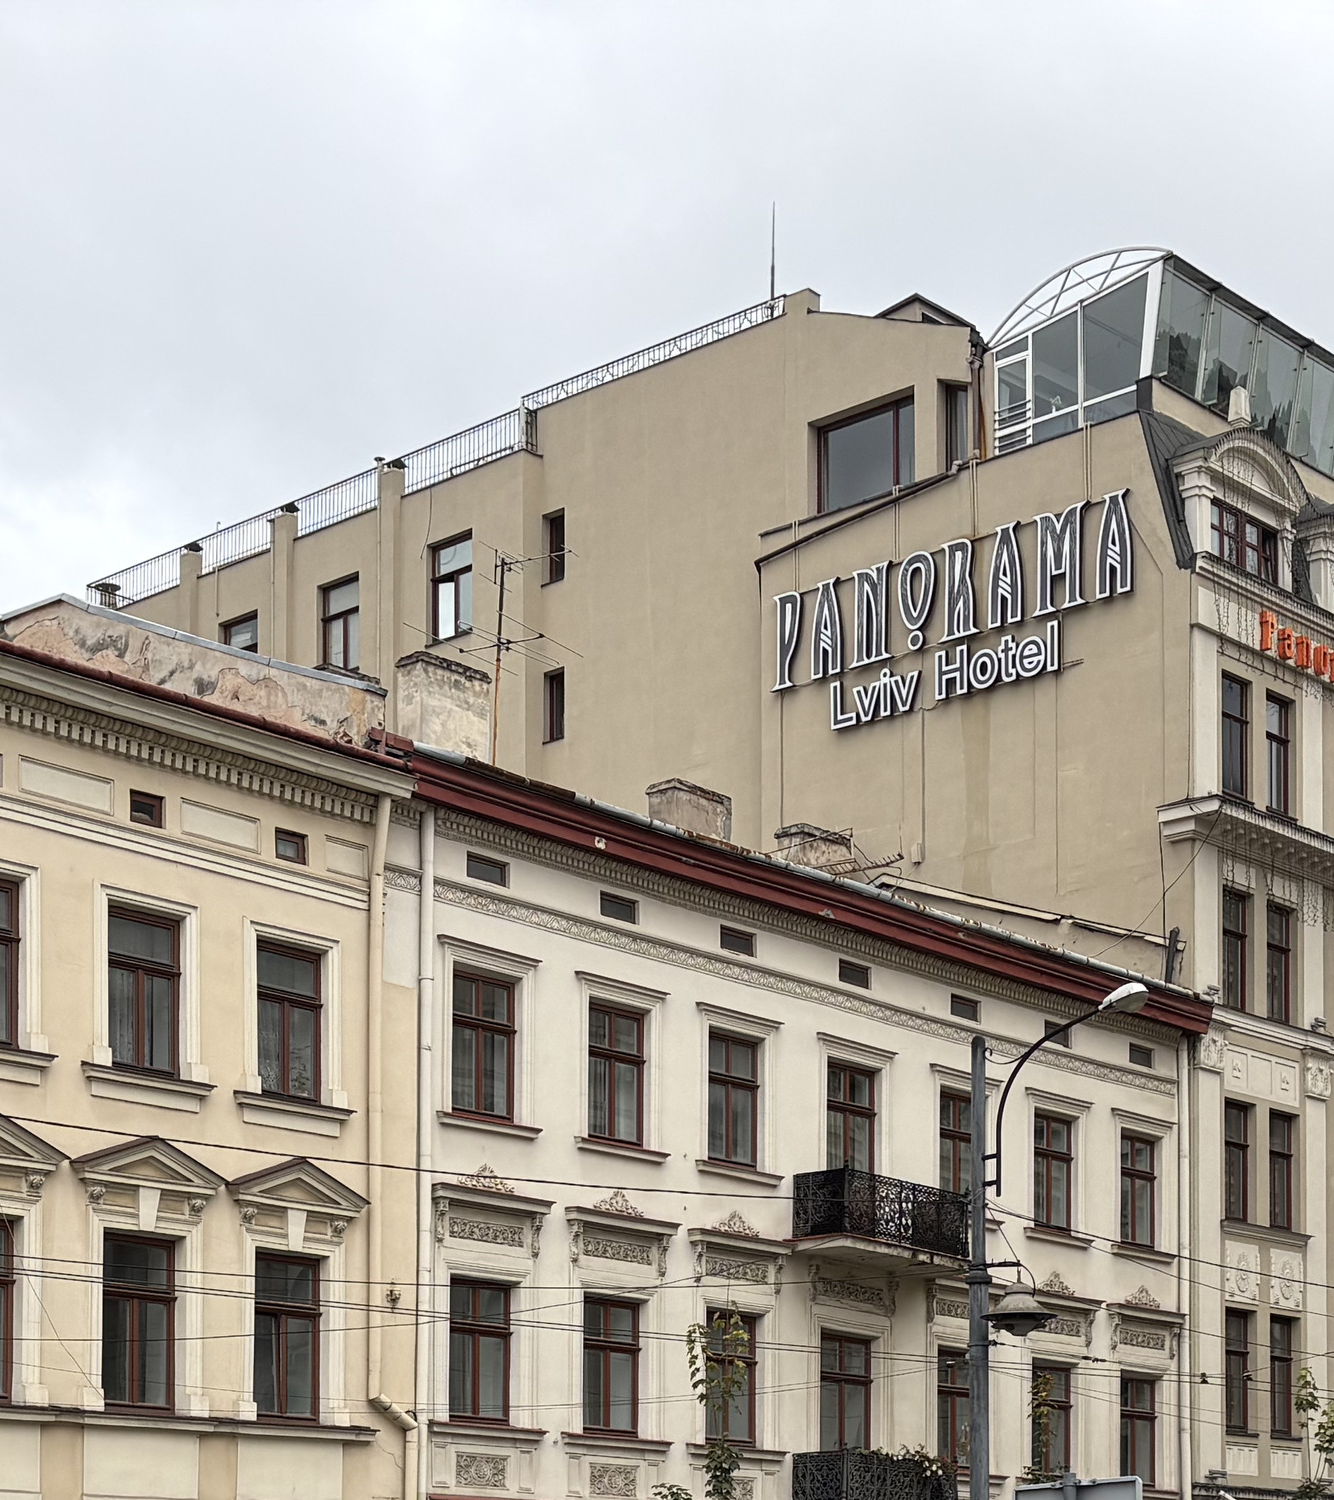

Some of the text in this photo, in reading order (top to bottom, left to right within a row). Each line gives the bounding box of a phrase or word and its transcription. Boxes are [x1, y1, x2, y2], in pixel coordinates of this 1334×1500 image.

[771, 488, 1134, 693] PANORAMA
[829, 620, 1064, 730] Lviv Hotel
